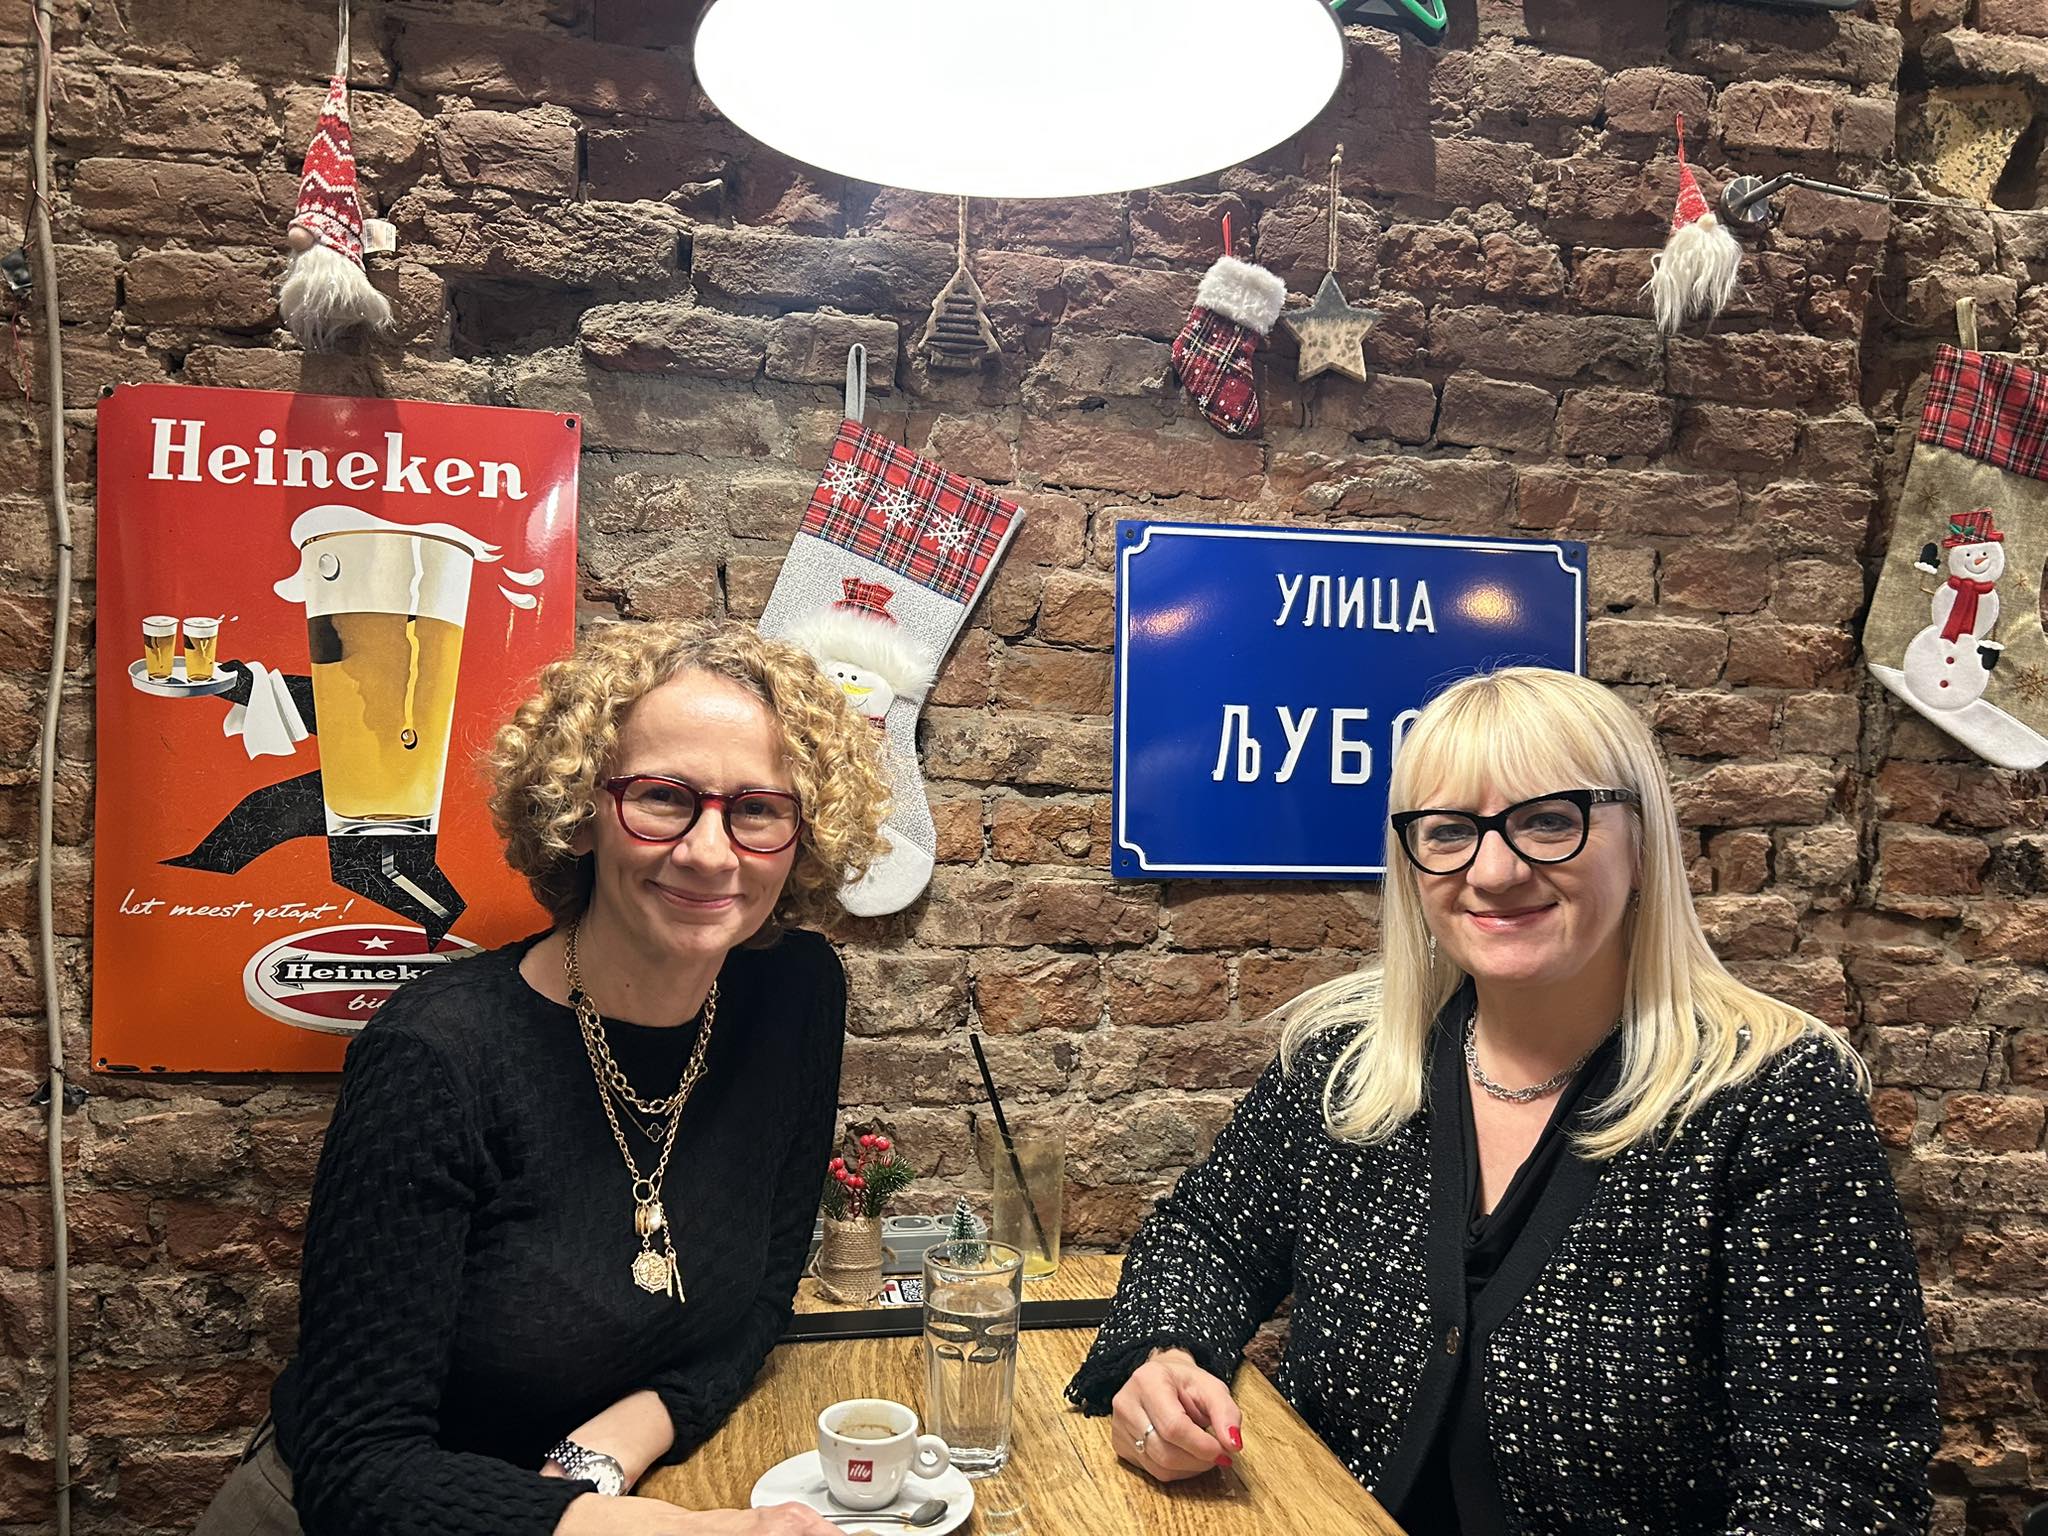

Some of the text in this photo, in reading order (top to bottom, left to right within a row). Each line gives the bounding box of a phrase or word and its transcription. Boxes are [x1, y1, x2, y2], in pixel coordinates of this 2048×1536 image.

[148, 417, 528, 501] Heineken
[1274, 573, 1436, 634] УЛИЦА
[169, 900, 253, 918] meest
[284, 963, 433, 980] Heinek
[849, 1463, 871, 1478] illy
